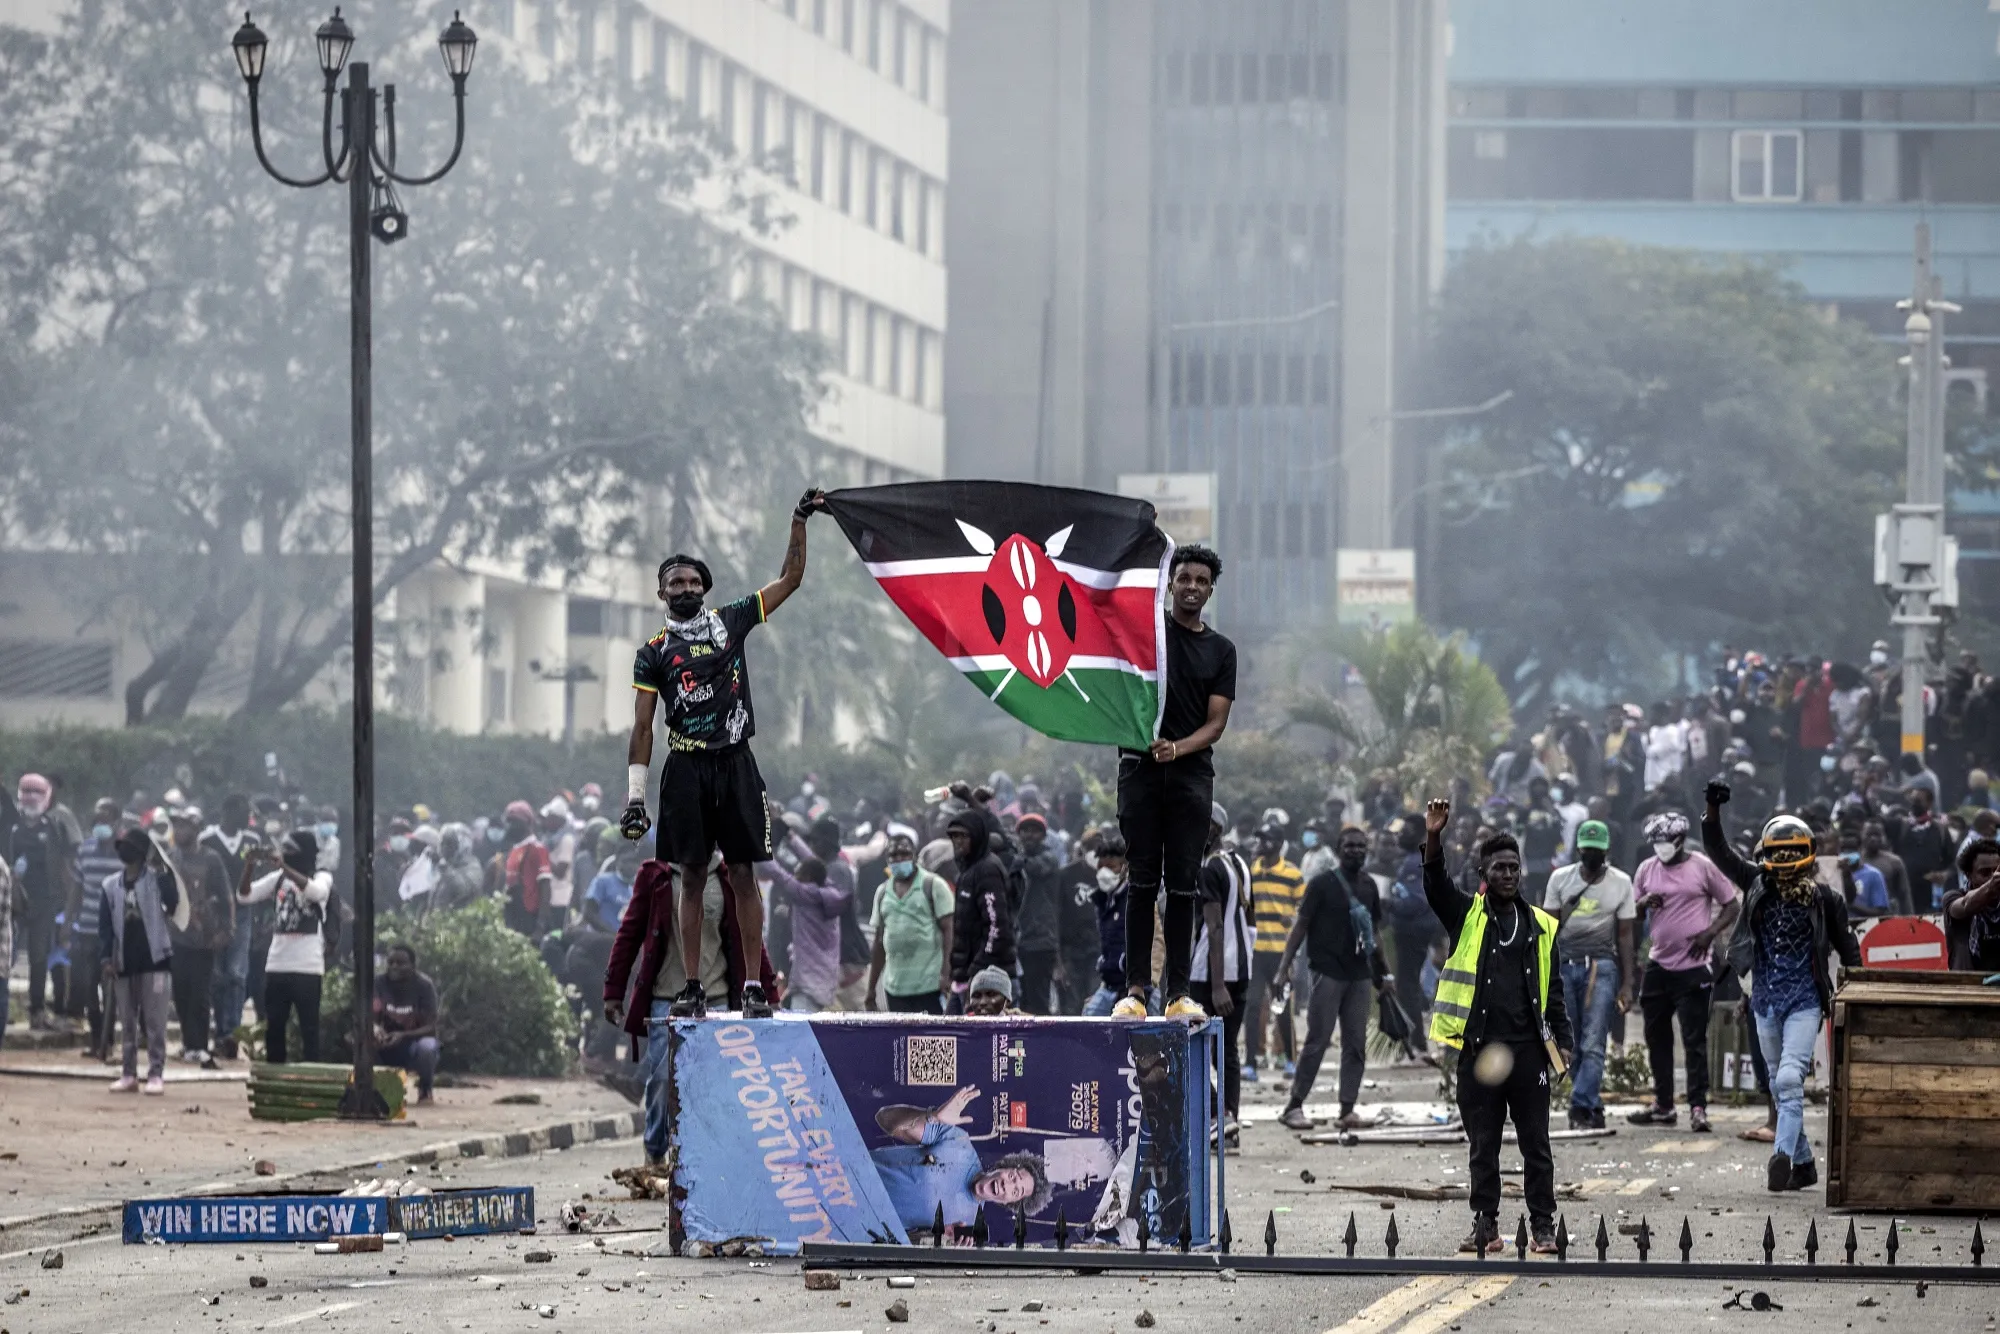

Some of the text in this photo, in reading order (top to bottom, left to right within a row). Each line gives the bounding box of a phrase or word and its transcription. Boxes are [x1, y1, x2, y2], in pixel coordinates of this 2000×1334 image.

[999, 1034, 1008, 1055] PAY
[999, 1092, 1008, 1112] PAY
[1071, 1082, 1083, 1130] 79079
[1091, 1080, 1099, 1134] PLAY NOW
[714, 1024, 837, 1244] OPPORTUNITY
[770, 1056, 858, 1208] TAKE EVERY
[137, 1204, 192, 1234] WIN
[201, 1204, 276, 1233] HERE
[287, 1203, 356, 1233] NOW
[400, 1202, 430, 1233] WIN
[432, 1197, 474, 1229] HERE
[478, 1194, 515, 1227] NOW
